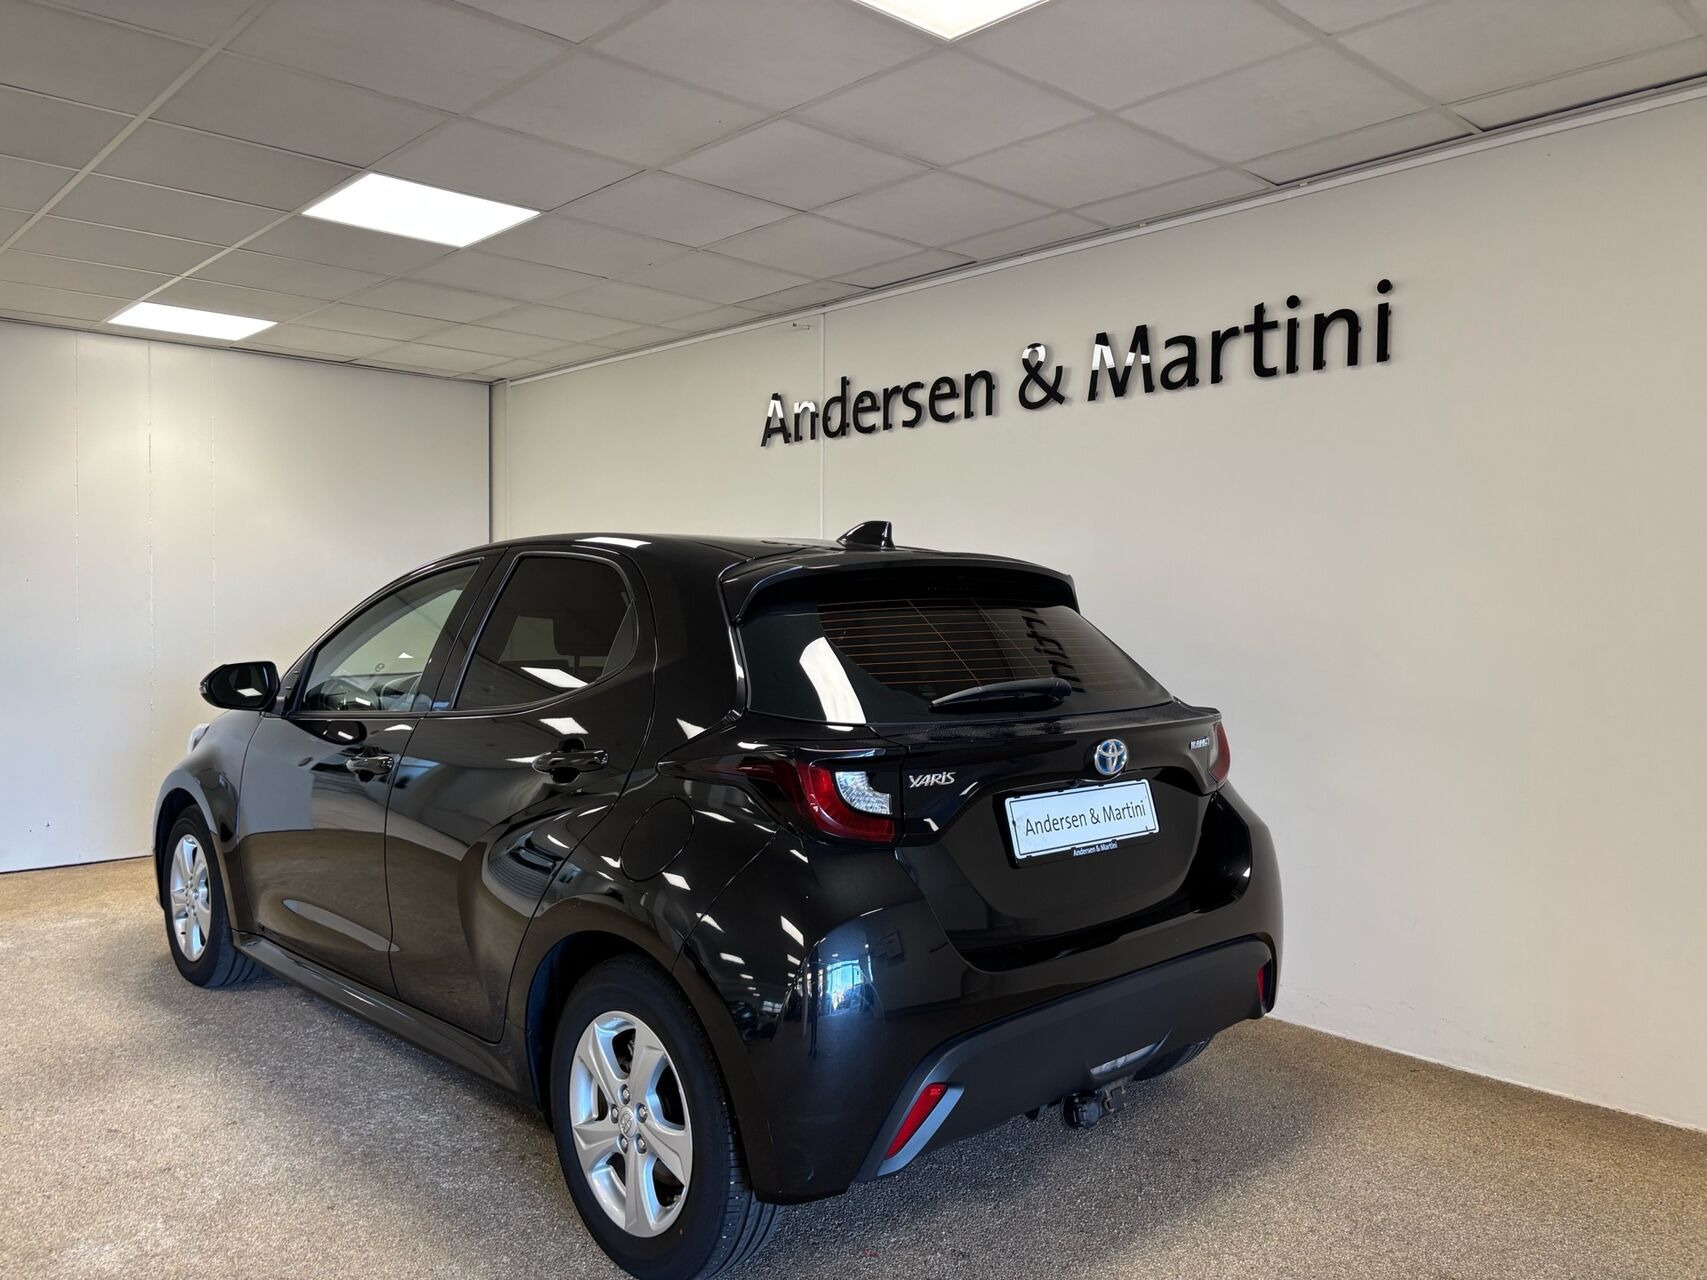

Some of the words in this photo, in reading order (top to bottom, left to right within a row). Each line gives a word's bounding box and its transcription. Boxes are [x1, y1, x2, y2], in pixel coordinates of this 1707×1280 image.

[760, 368, 997, 447] Andersen
[1018, 342, 1065, 410] &
[1088, 279, 1394, 402] Martini
[1025, 813, 1088, 836] Andersen
[1089, 807, 1100, 825] &
[1102, 799, 1146, 823] Martini
